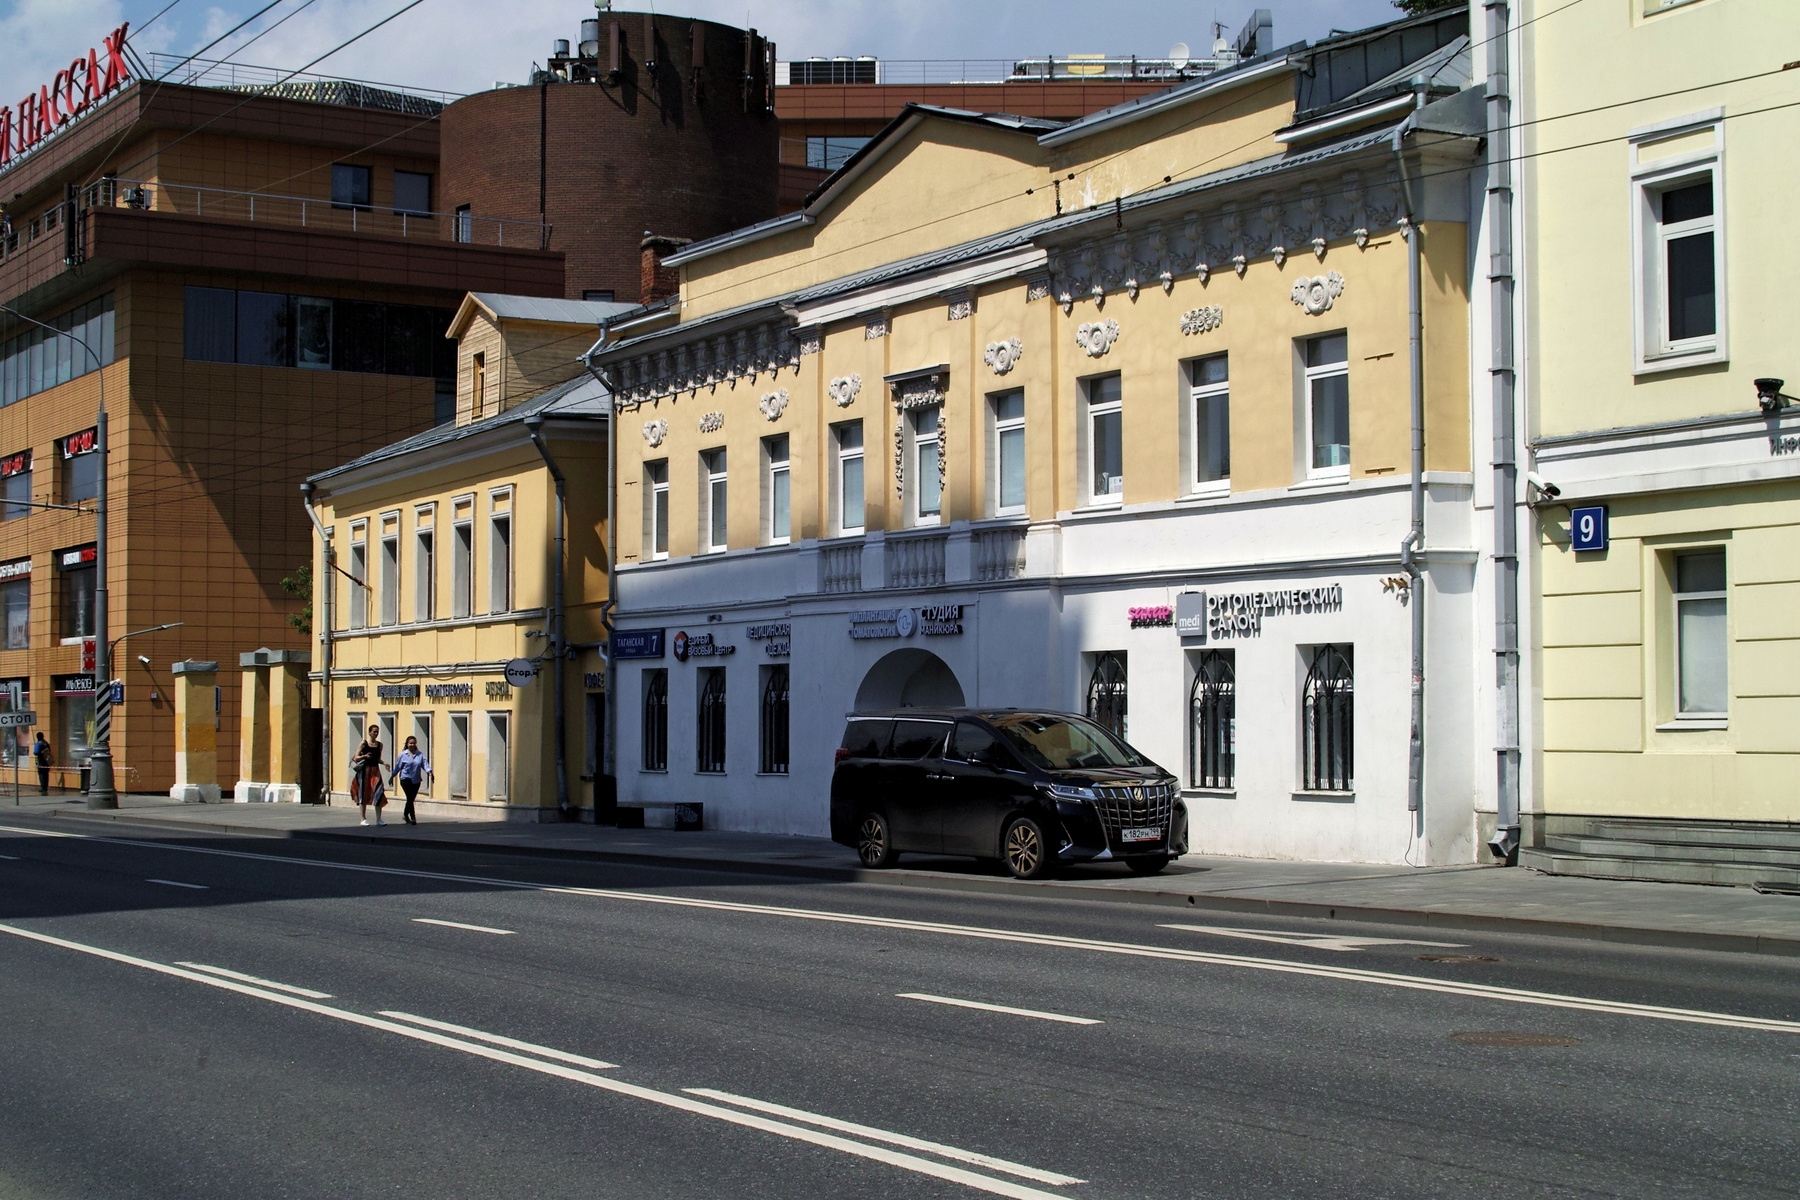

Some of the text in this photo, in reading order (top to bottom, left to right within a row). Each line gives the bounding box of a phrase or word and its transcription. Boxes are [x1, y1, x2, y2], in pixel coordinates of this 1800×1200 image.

[16, 21, 130, 154] ПАССАЖ
[1769, 436, 1800, 456] ИНФ
[1580, 515, 1595, 543] 9
[1208, 584, 1340, 610] ОРТОПЕДИЧЕСКИЙ
[921, 605, 960, 621] СТУДИЯ
[1179, 614, 1200, 628] medi
[746, 624, 791, 638] МЕДИЦИНСКАЯ
[920, 624, 960, 636] МАНИКЮРА
[1208, 614, 1259, 632] САЛОН
[617, 637, 645, 647] ТАГАНСКАЯ
[651, 635, 657, 652] 7
[1, 714, 31, 724] СТОП
